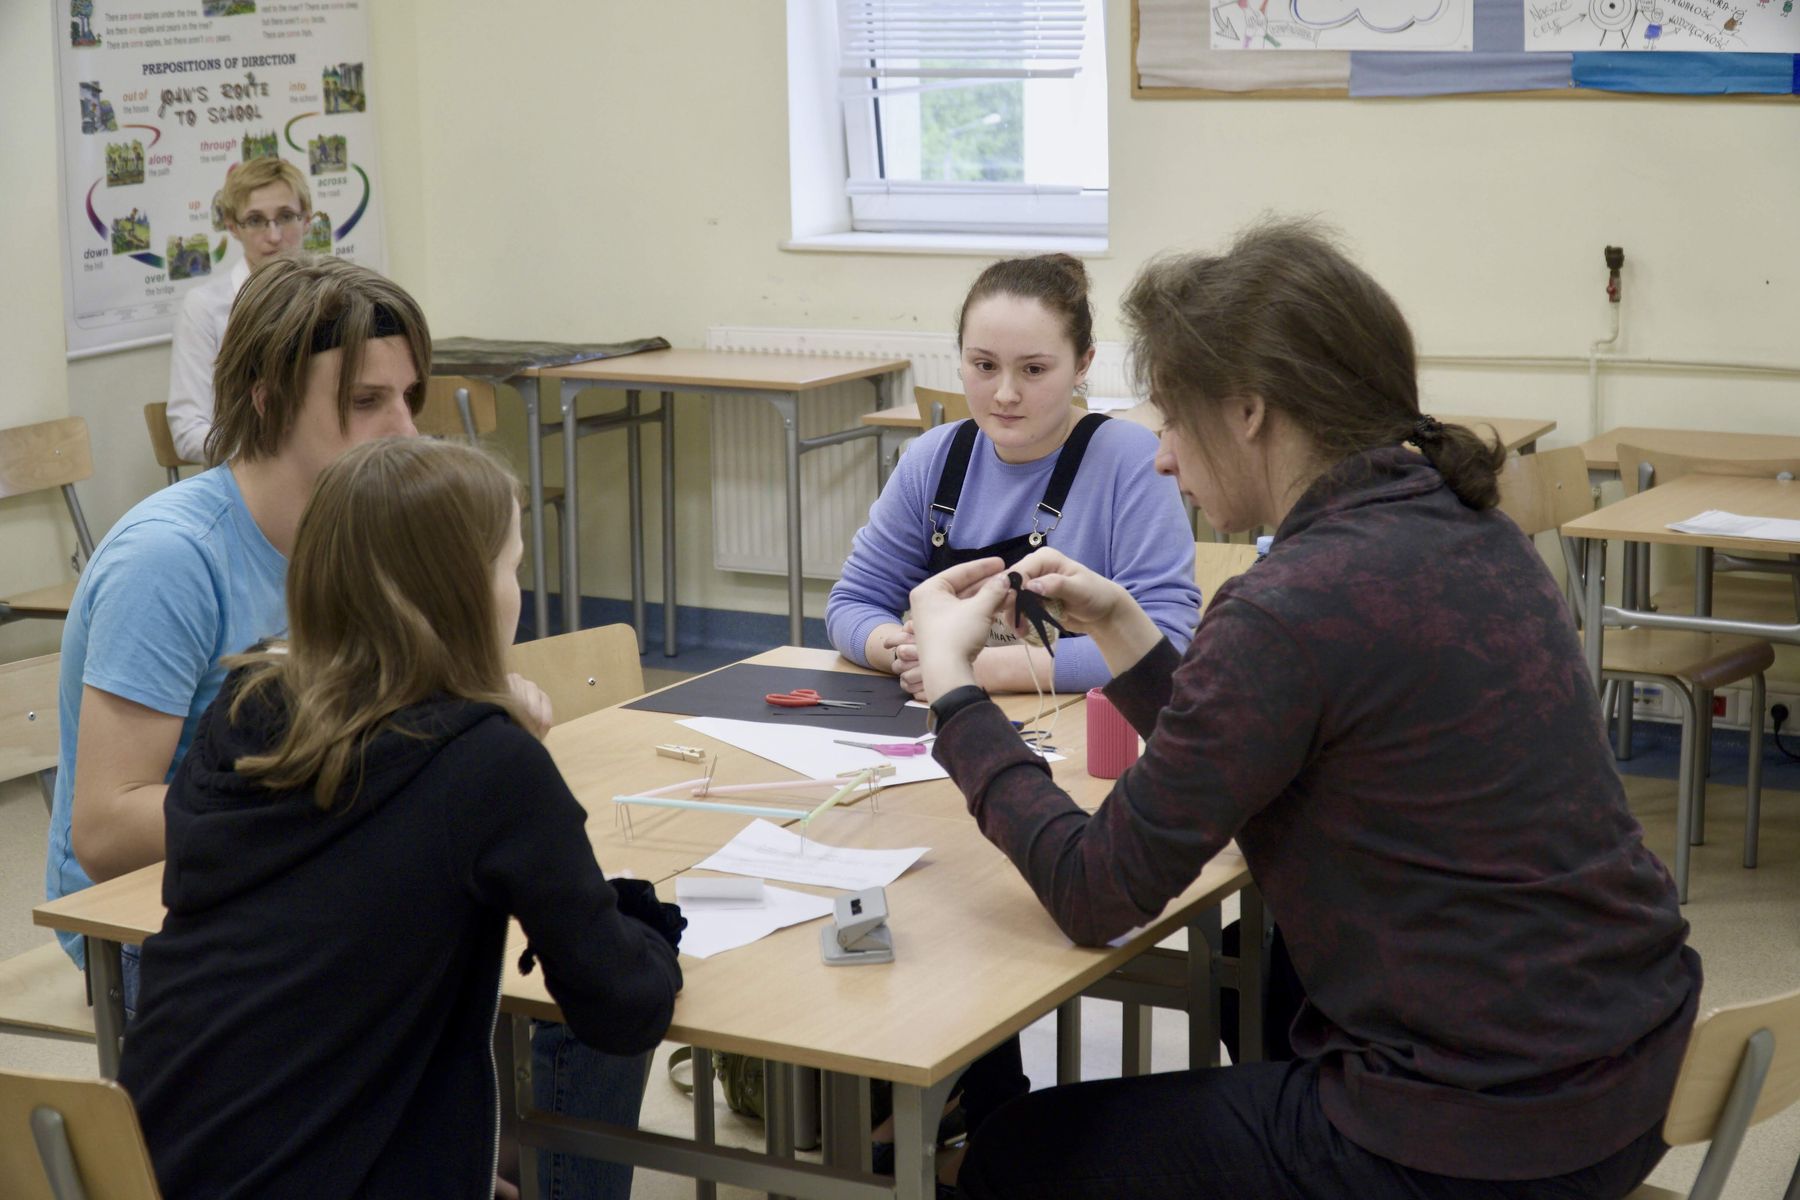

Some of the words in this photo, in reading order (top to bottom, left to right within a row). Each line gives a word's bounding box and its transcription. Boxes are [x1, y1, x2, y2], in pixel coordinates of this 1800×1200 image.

[142, 58, 222, 75] PREPOSITIONS
[224, 57, 239, 69] OF
[242, 53, 296, 68] DIRECTION
[289, 80, 307, 92] into
[123, 91, 138, 102] out
[138, 88, 148, 101] of
[175, 109, 197, 127] TO
[207, 103, 263, 124] SCHOOL
[200, 137, 237, 152] through
[148, 153, 173, 167] along
[317, 176, 347, 188] across
[188, 200, 202, 212] up
[83, 246, 109, 260] down
[336, 244, 354, 257] past
[144, 272, 167, 285] over
